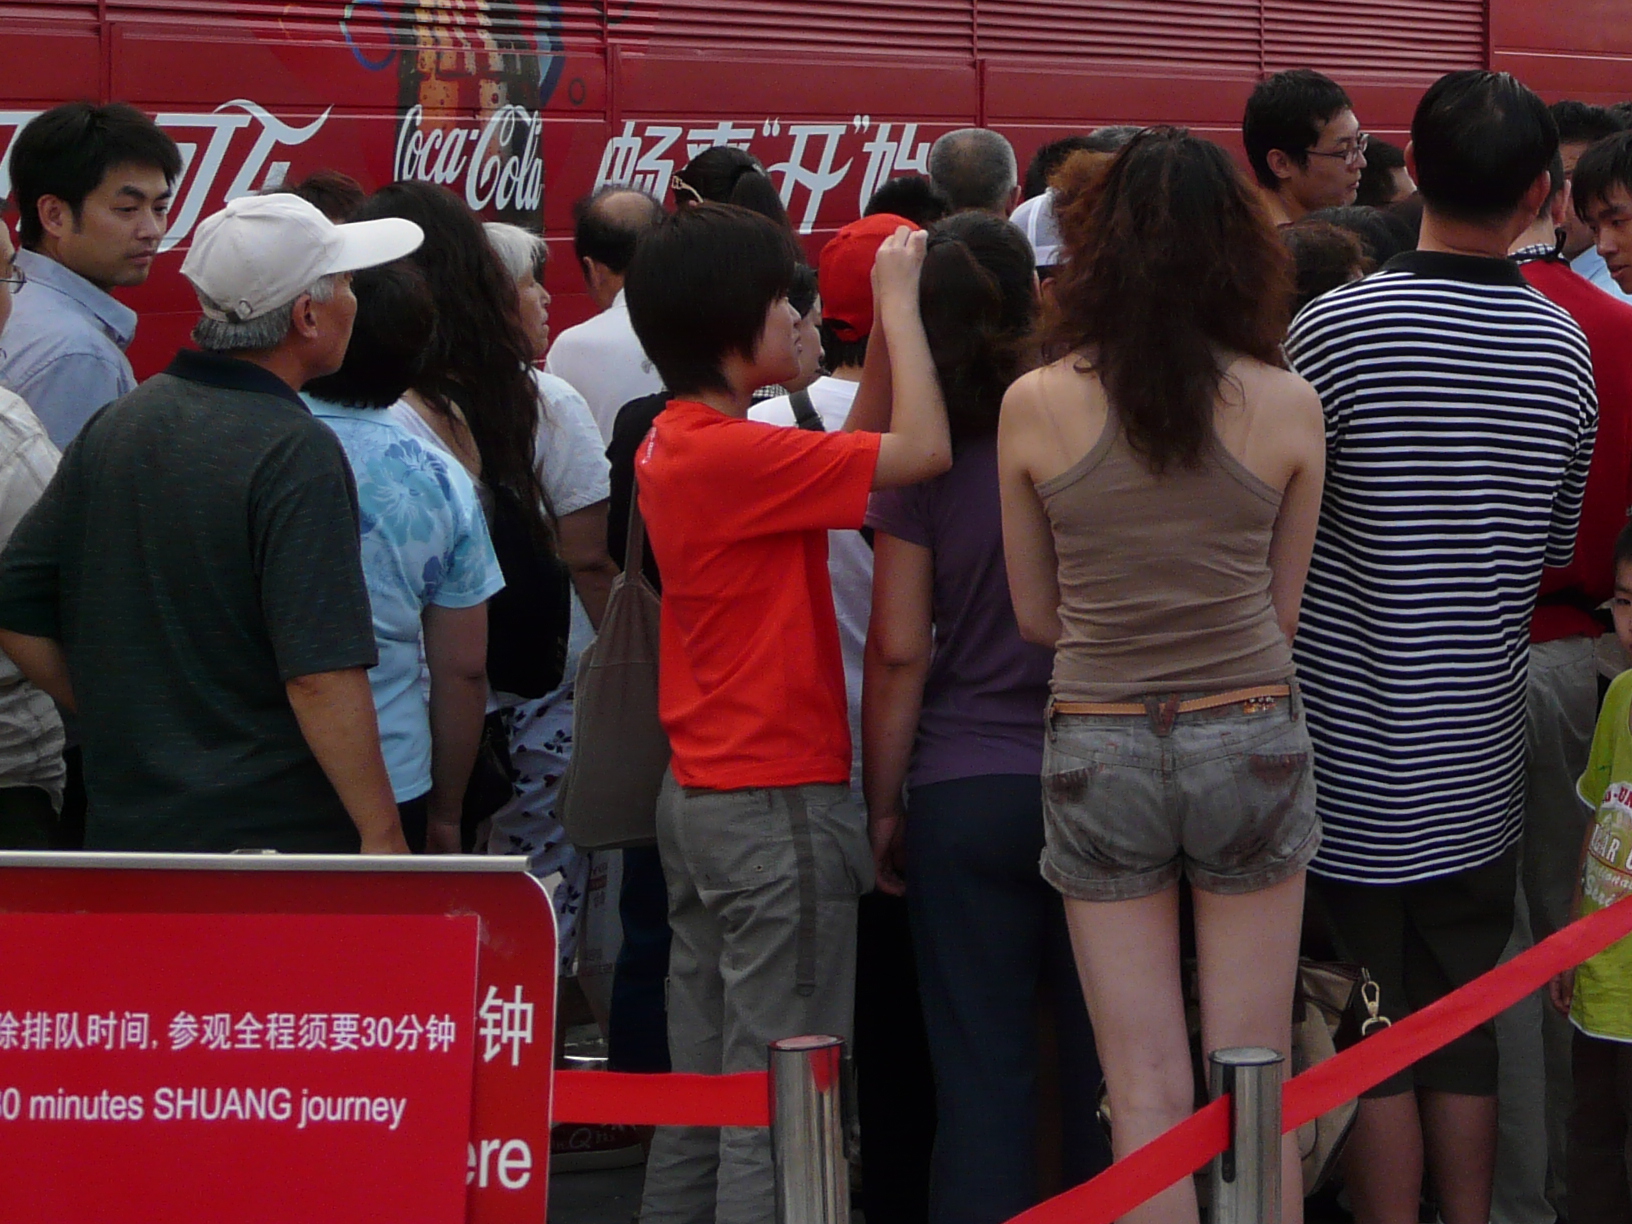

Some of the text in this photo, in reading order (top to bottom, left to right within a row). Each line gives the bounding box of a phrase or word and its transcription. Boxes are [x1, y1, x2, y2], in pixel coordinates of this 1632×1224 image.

[393, 104, 543, 212] Coca-Cola
[479, 984, 535, 1067] 钟
[0, 1087, 406, 1130] 0 minutes SHUANG journey
